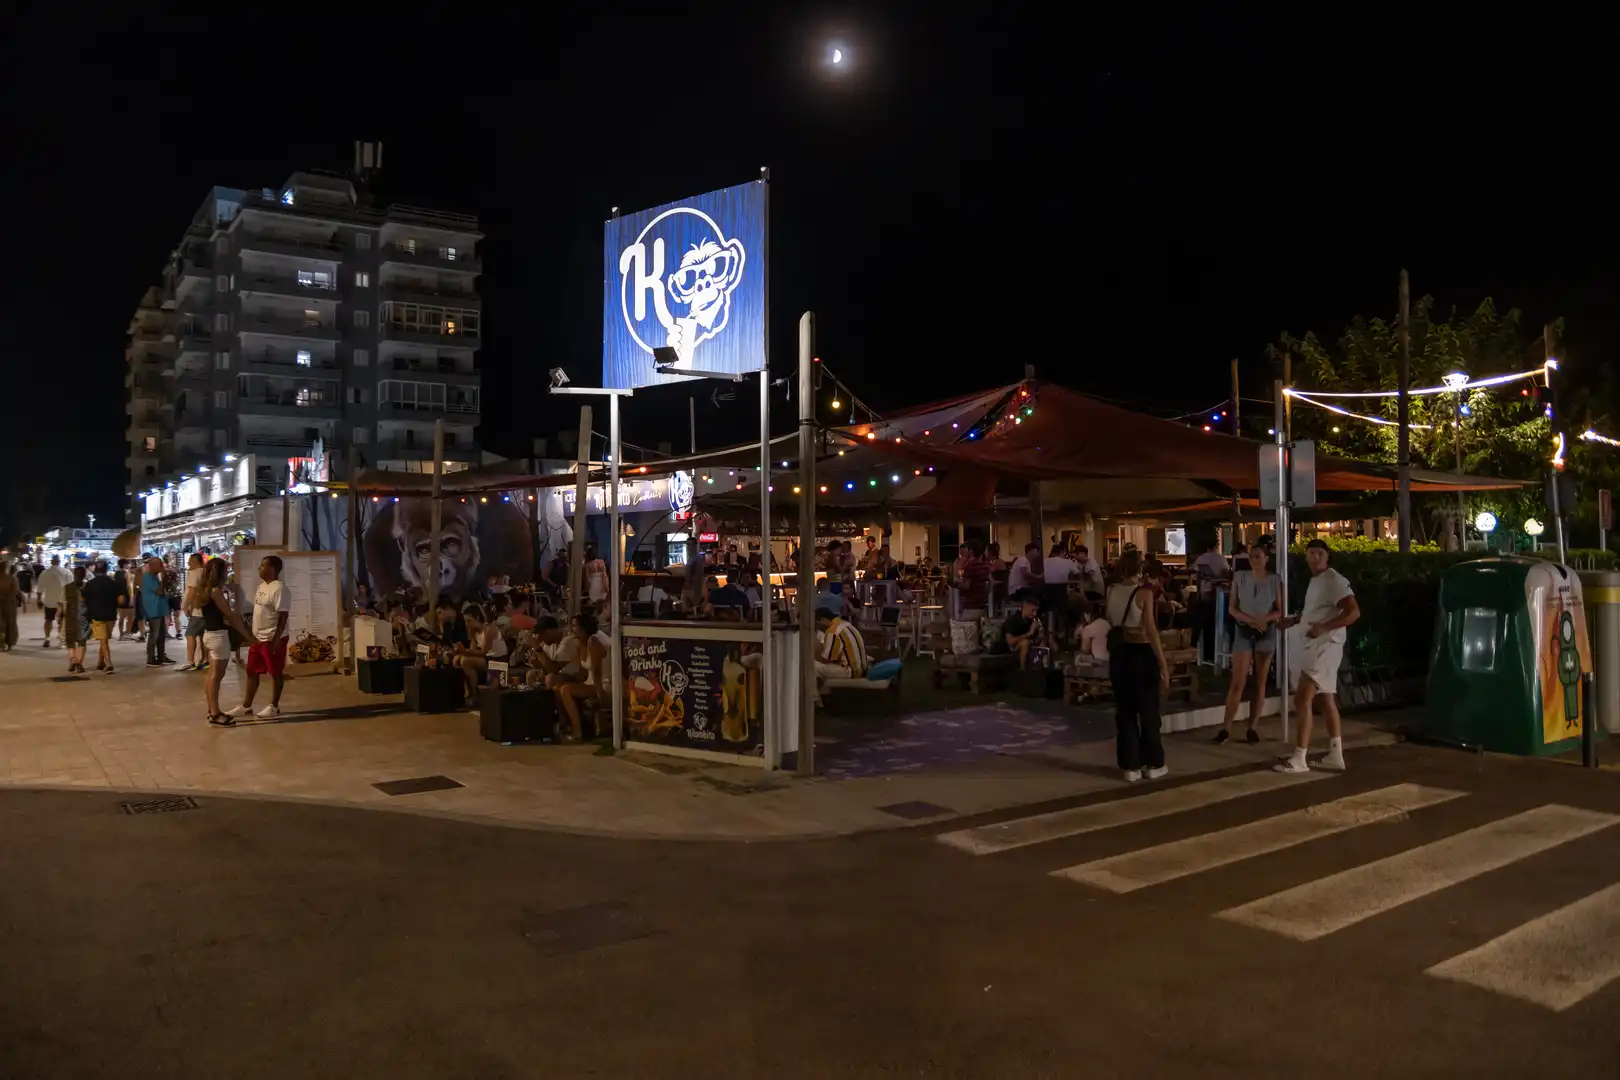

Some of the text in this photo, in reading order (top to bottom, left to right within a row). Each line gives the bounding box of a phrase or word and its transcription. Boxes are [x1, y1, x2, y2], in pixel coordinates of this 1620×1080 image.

[624, 641, 668, 659] Food and
[628, 656, 662, 672] Drinks
